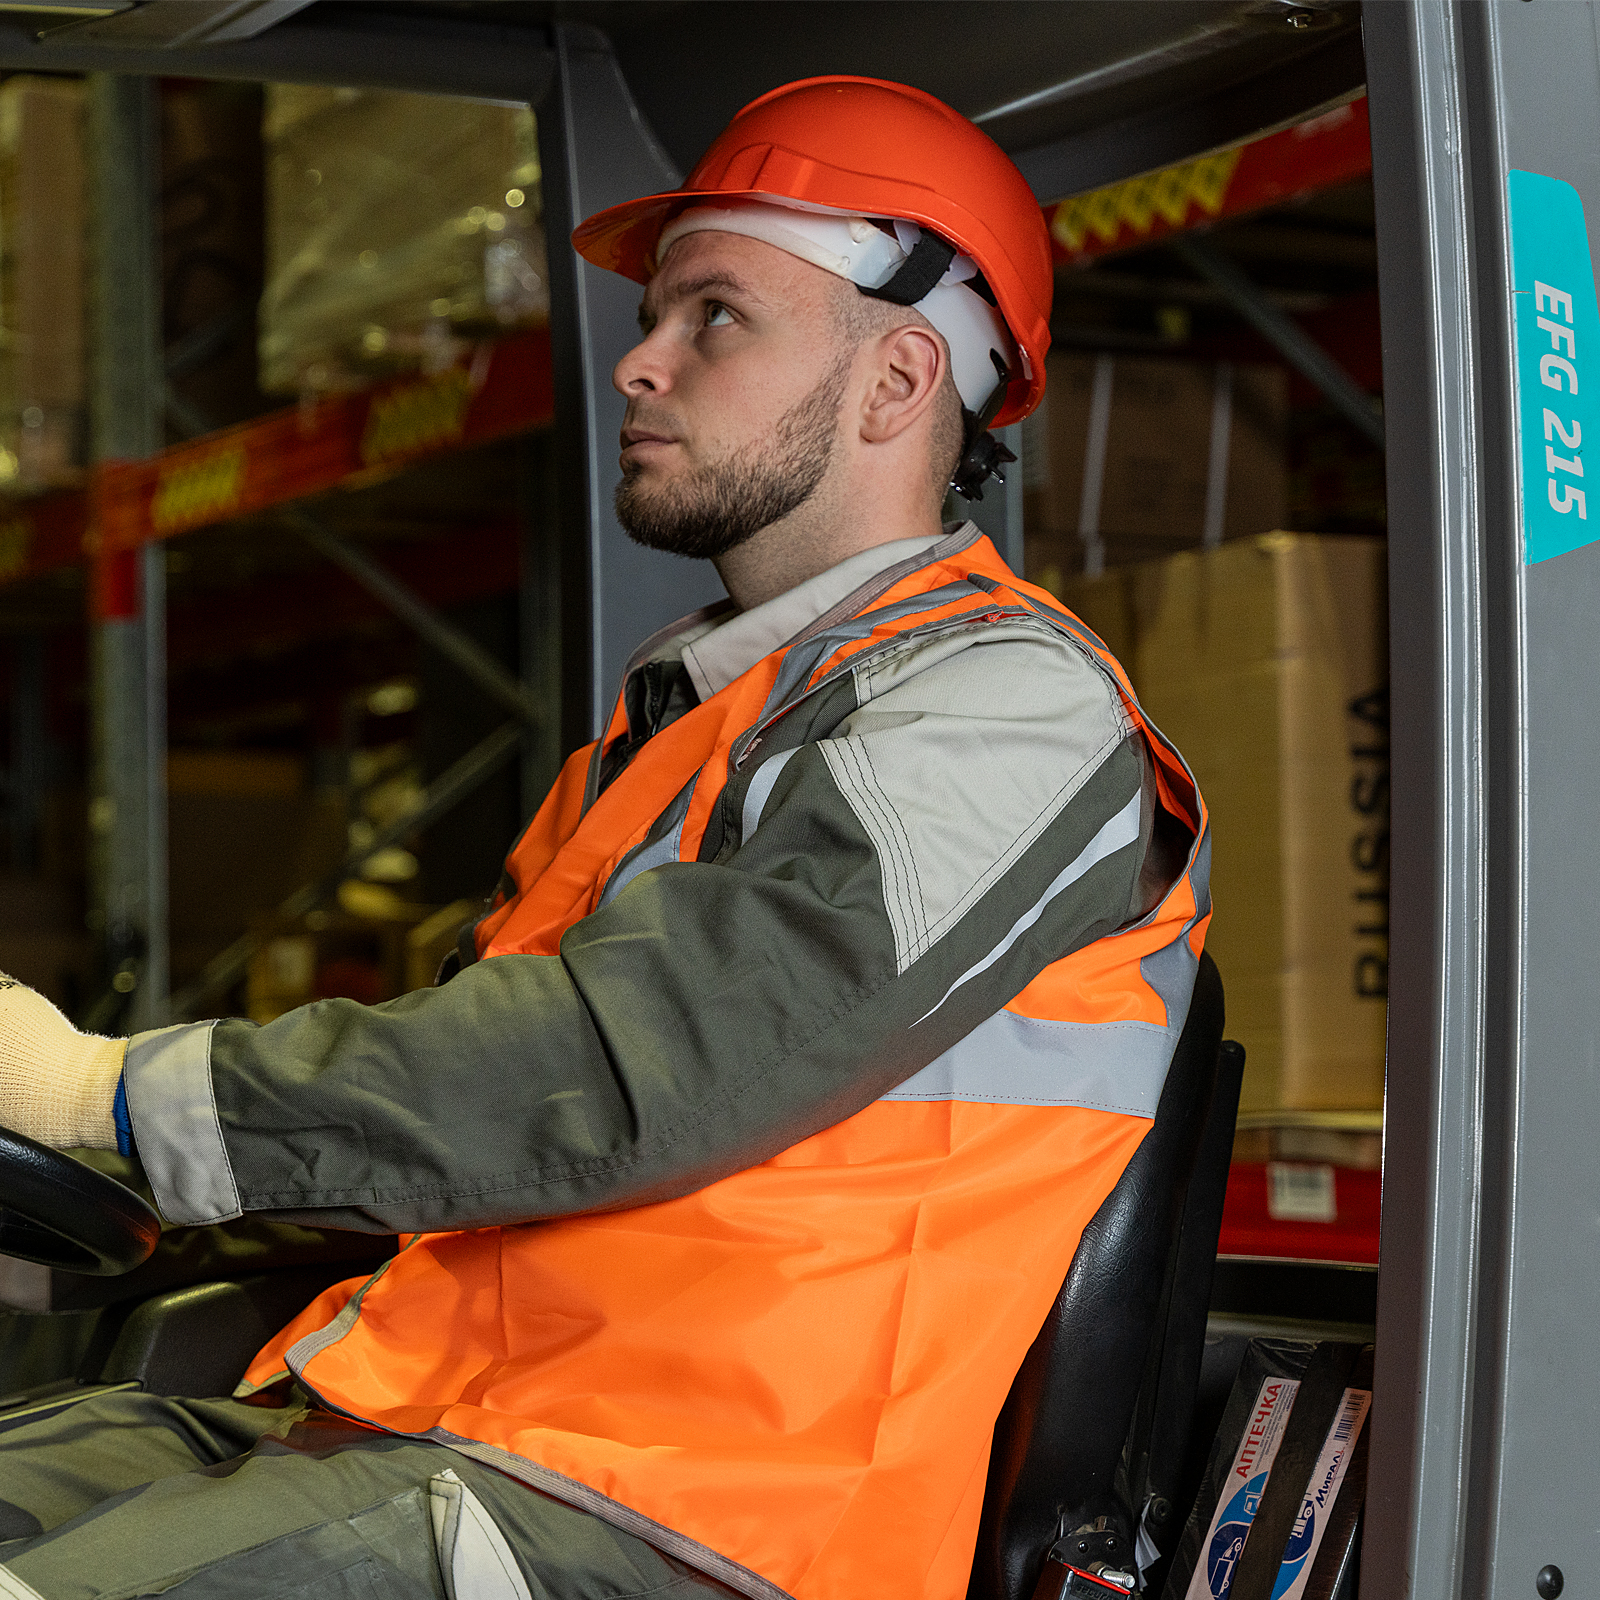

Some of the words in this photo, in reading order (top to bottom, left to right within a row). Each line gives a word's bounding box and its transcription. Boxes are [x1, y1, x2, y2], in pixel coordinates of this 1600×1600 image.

[1534, 280, 1578, 396] EFG
[1543, 407, 1588, 520] 215
[1235, 1383, 1283, 1479] АПТЕЧКА
